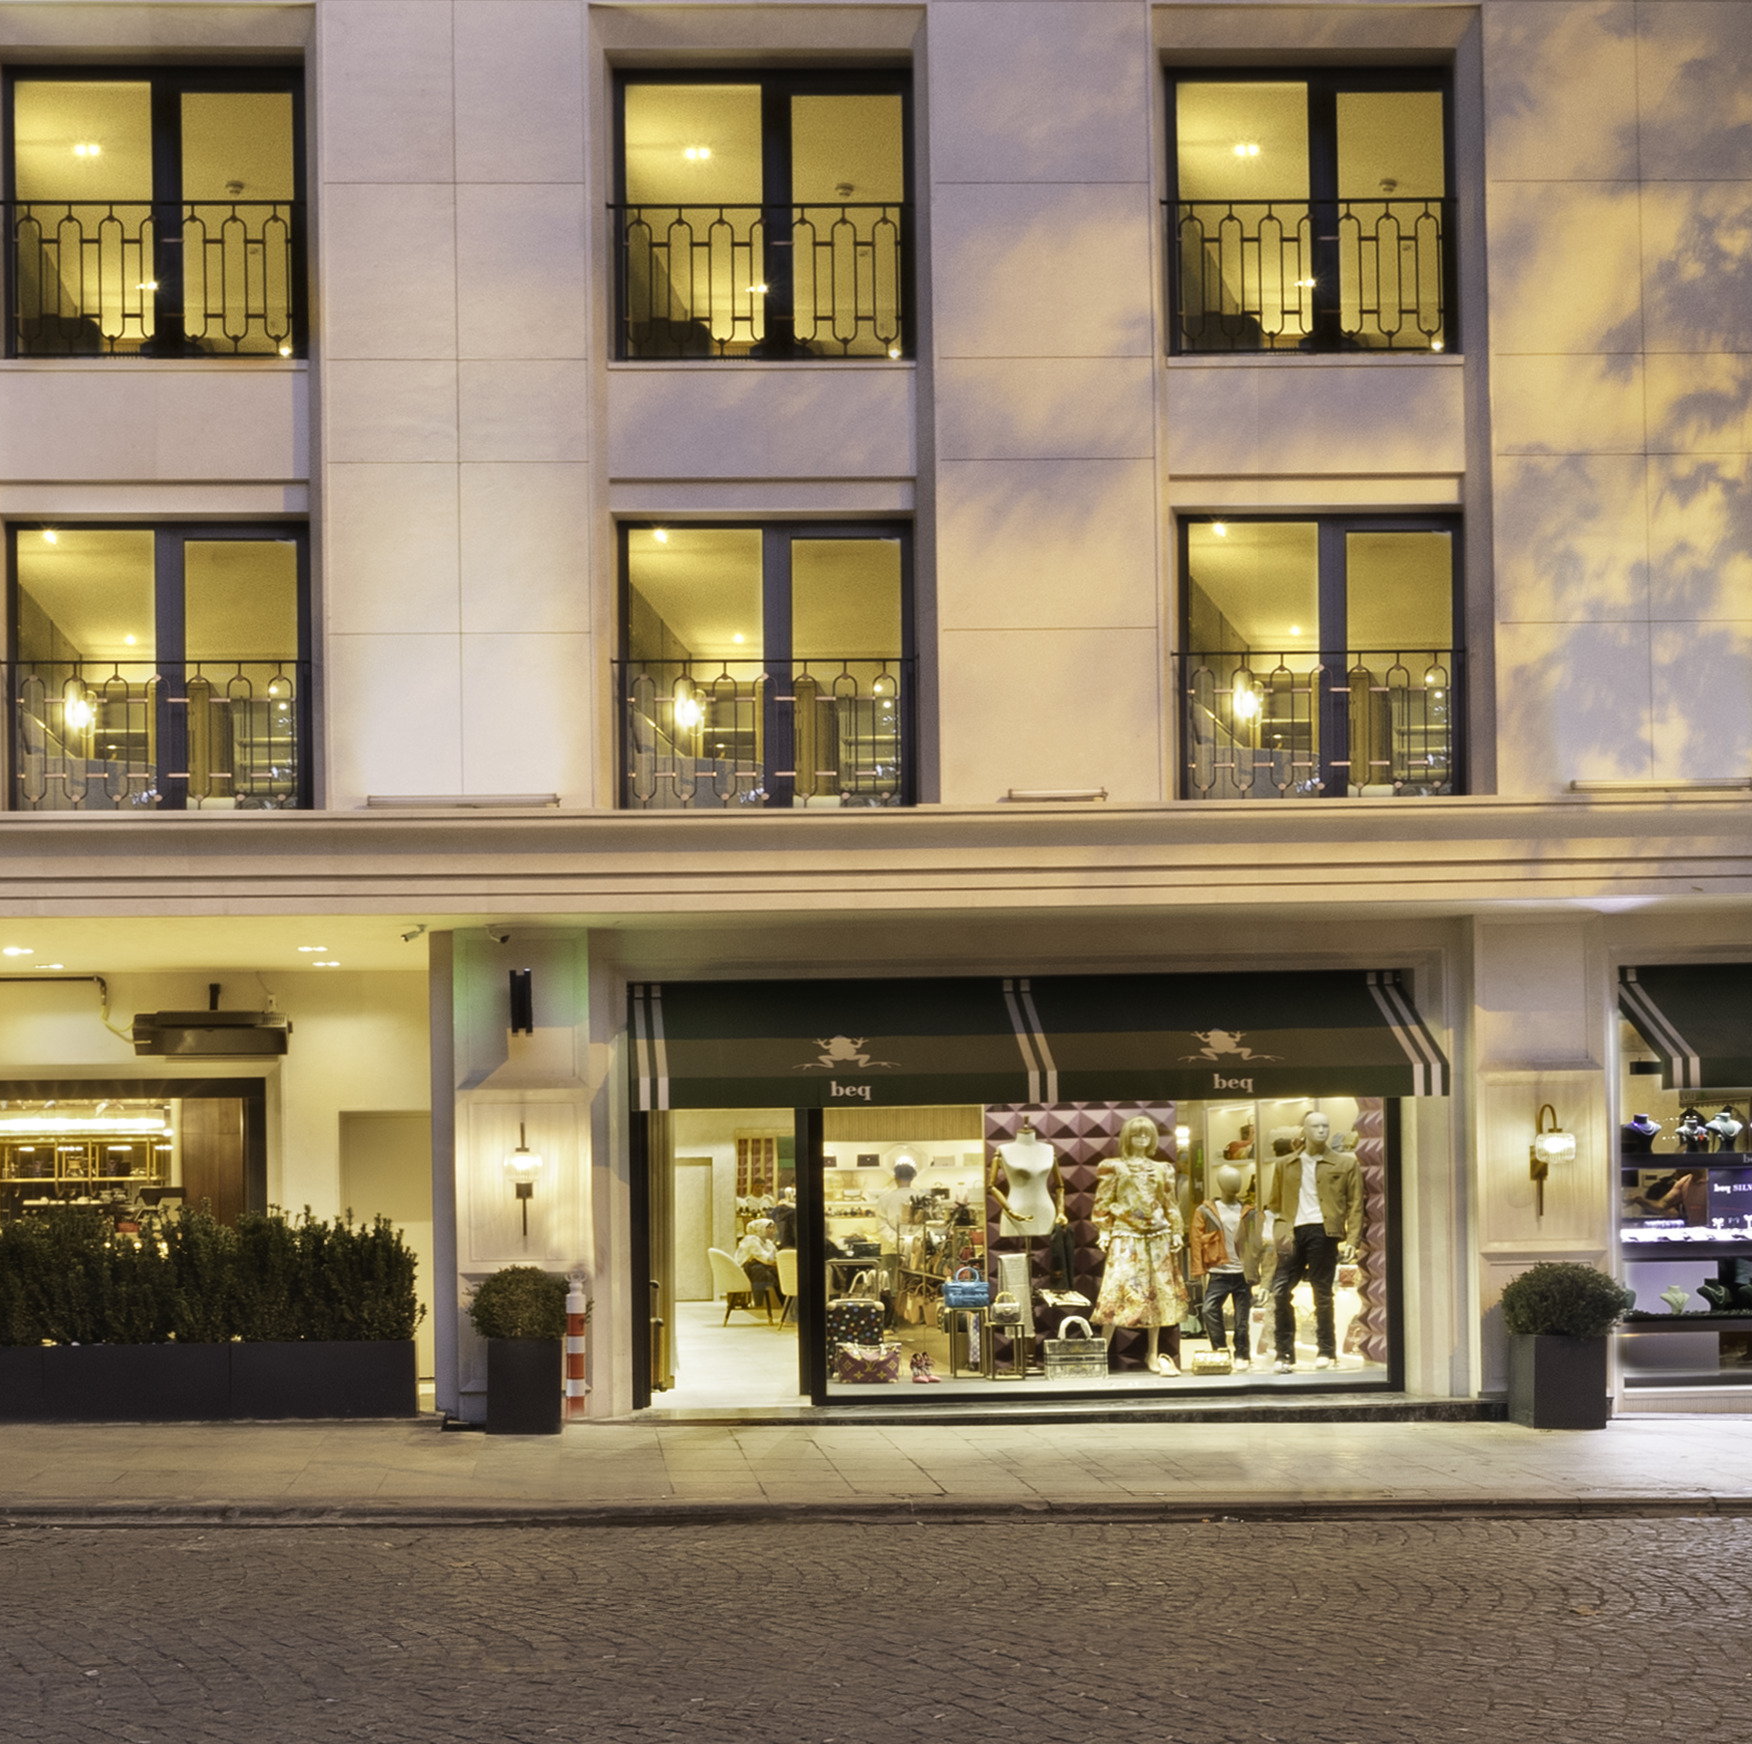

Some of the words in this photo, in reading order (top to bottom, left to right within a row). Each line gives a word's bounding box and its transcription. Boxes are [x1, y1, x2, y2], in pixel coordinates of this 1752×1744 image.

[830, 1080, 872, 1101] beq
[1213, 1073, 1254, 1093] beq
[1713, 1183, 1731, 1194] beq
